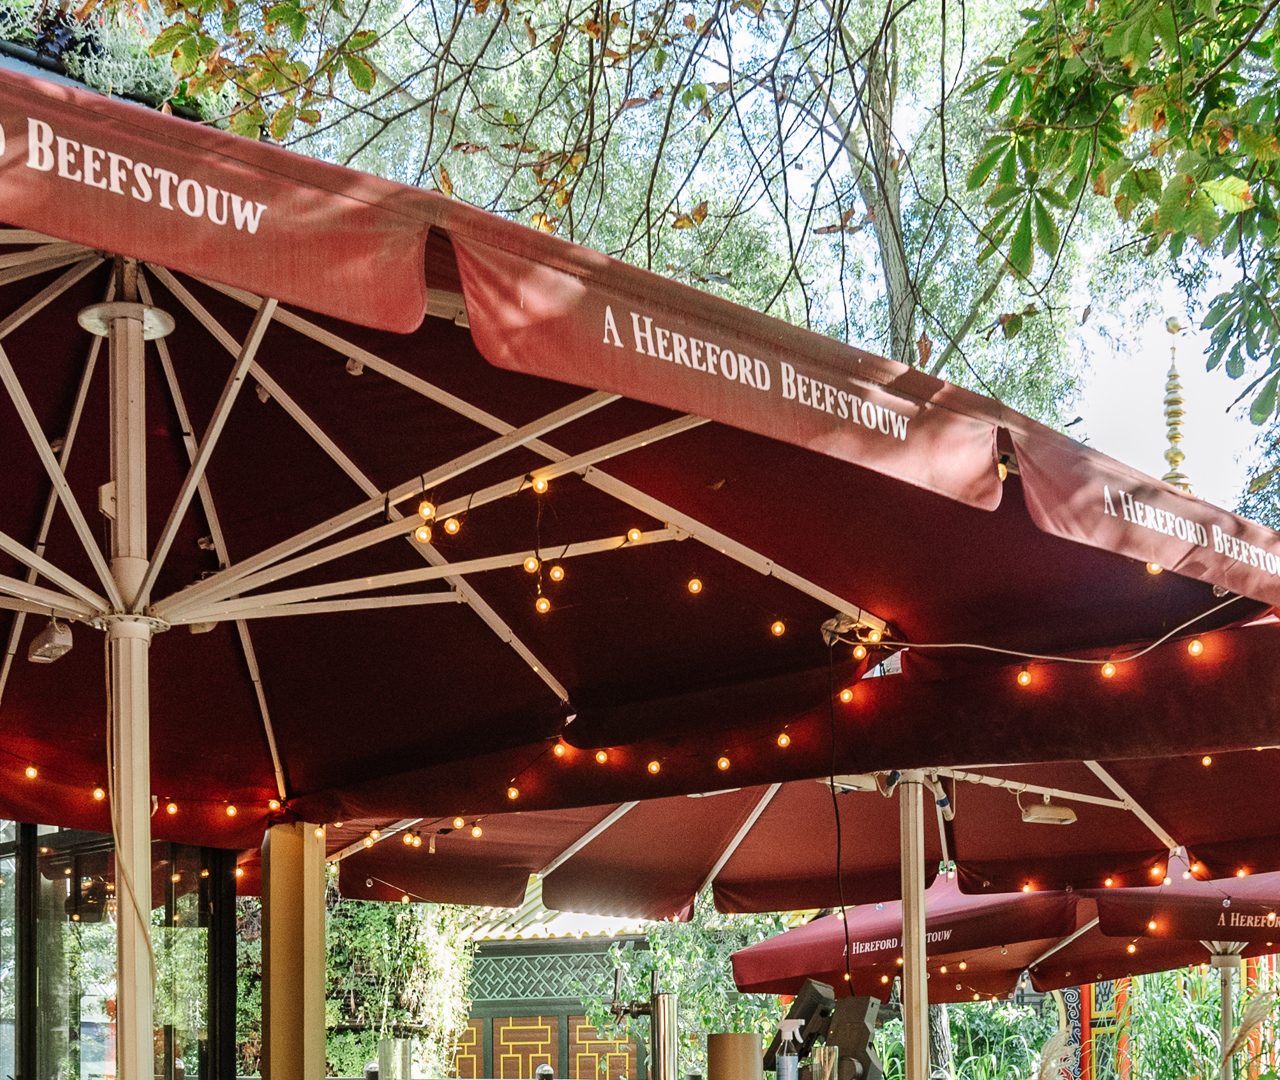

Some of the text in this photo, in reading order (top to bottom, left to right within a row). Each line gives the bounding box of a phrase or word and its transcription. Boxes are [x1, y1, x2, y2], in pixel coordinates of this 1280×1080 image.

[26, 117, 268, 234] BEEFSTOUW
[603, 305, 910, 441] A HEREFORD BEEFSTOUW
[1103, 485, 1118, 517] A
[1118, 489, 1208, 547] HEREFORD
[852, 938, 898, 954] HEREFORD
[1217, 912, 1226, 926] A
